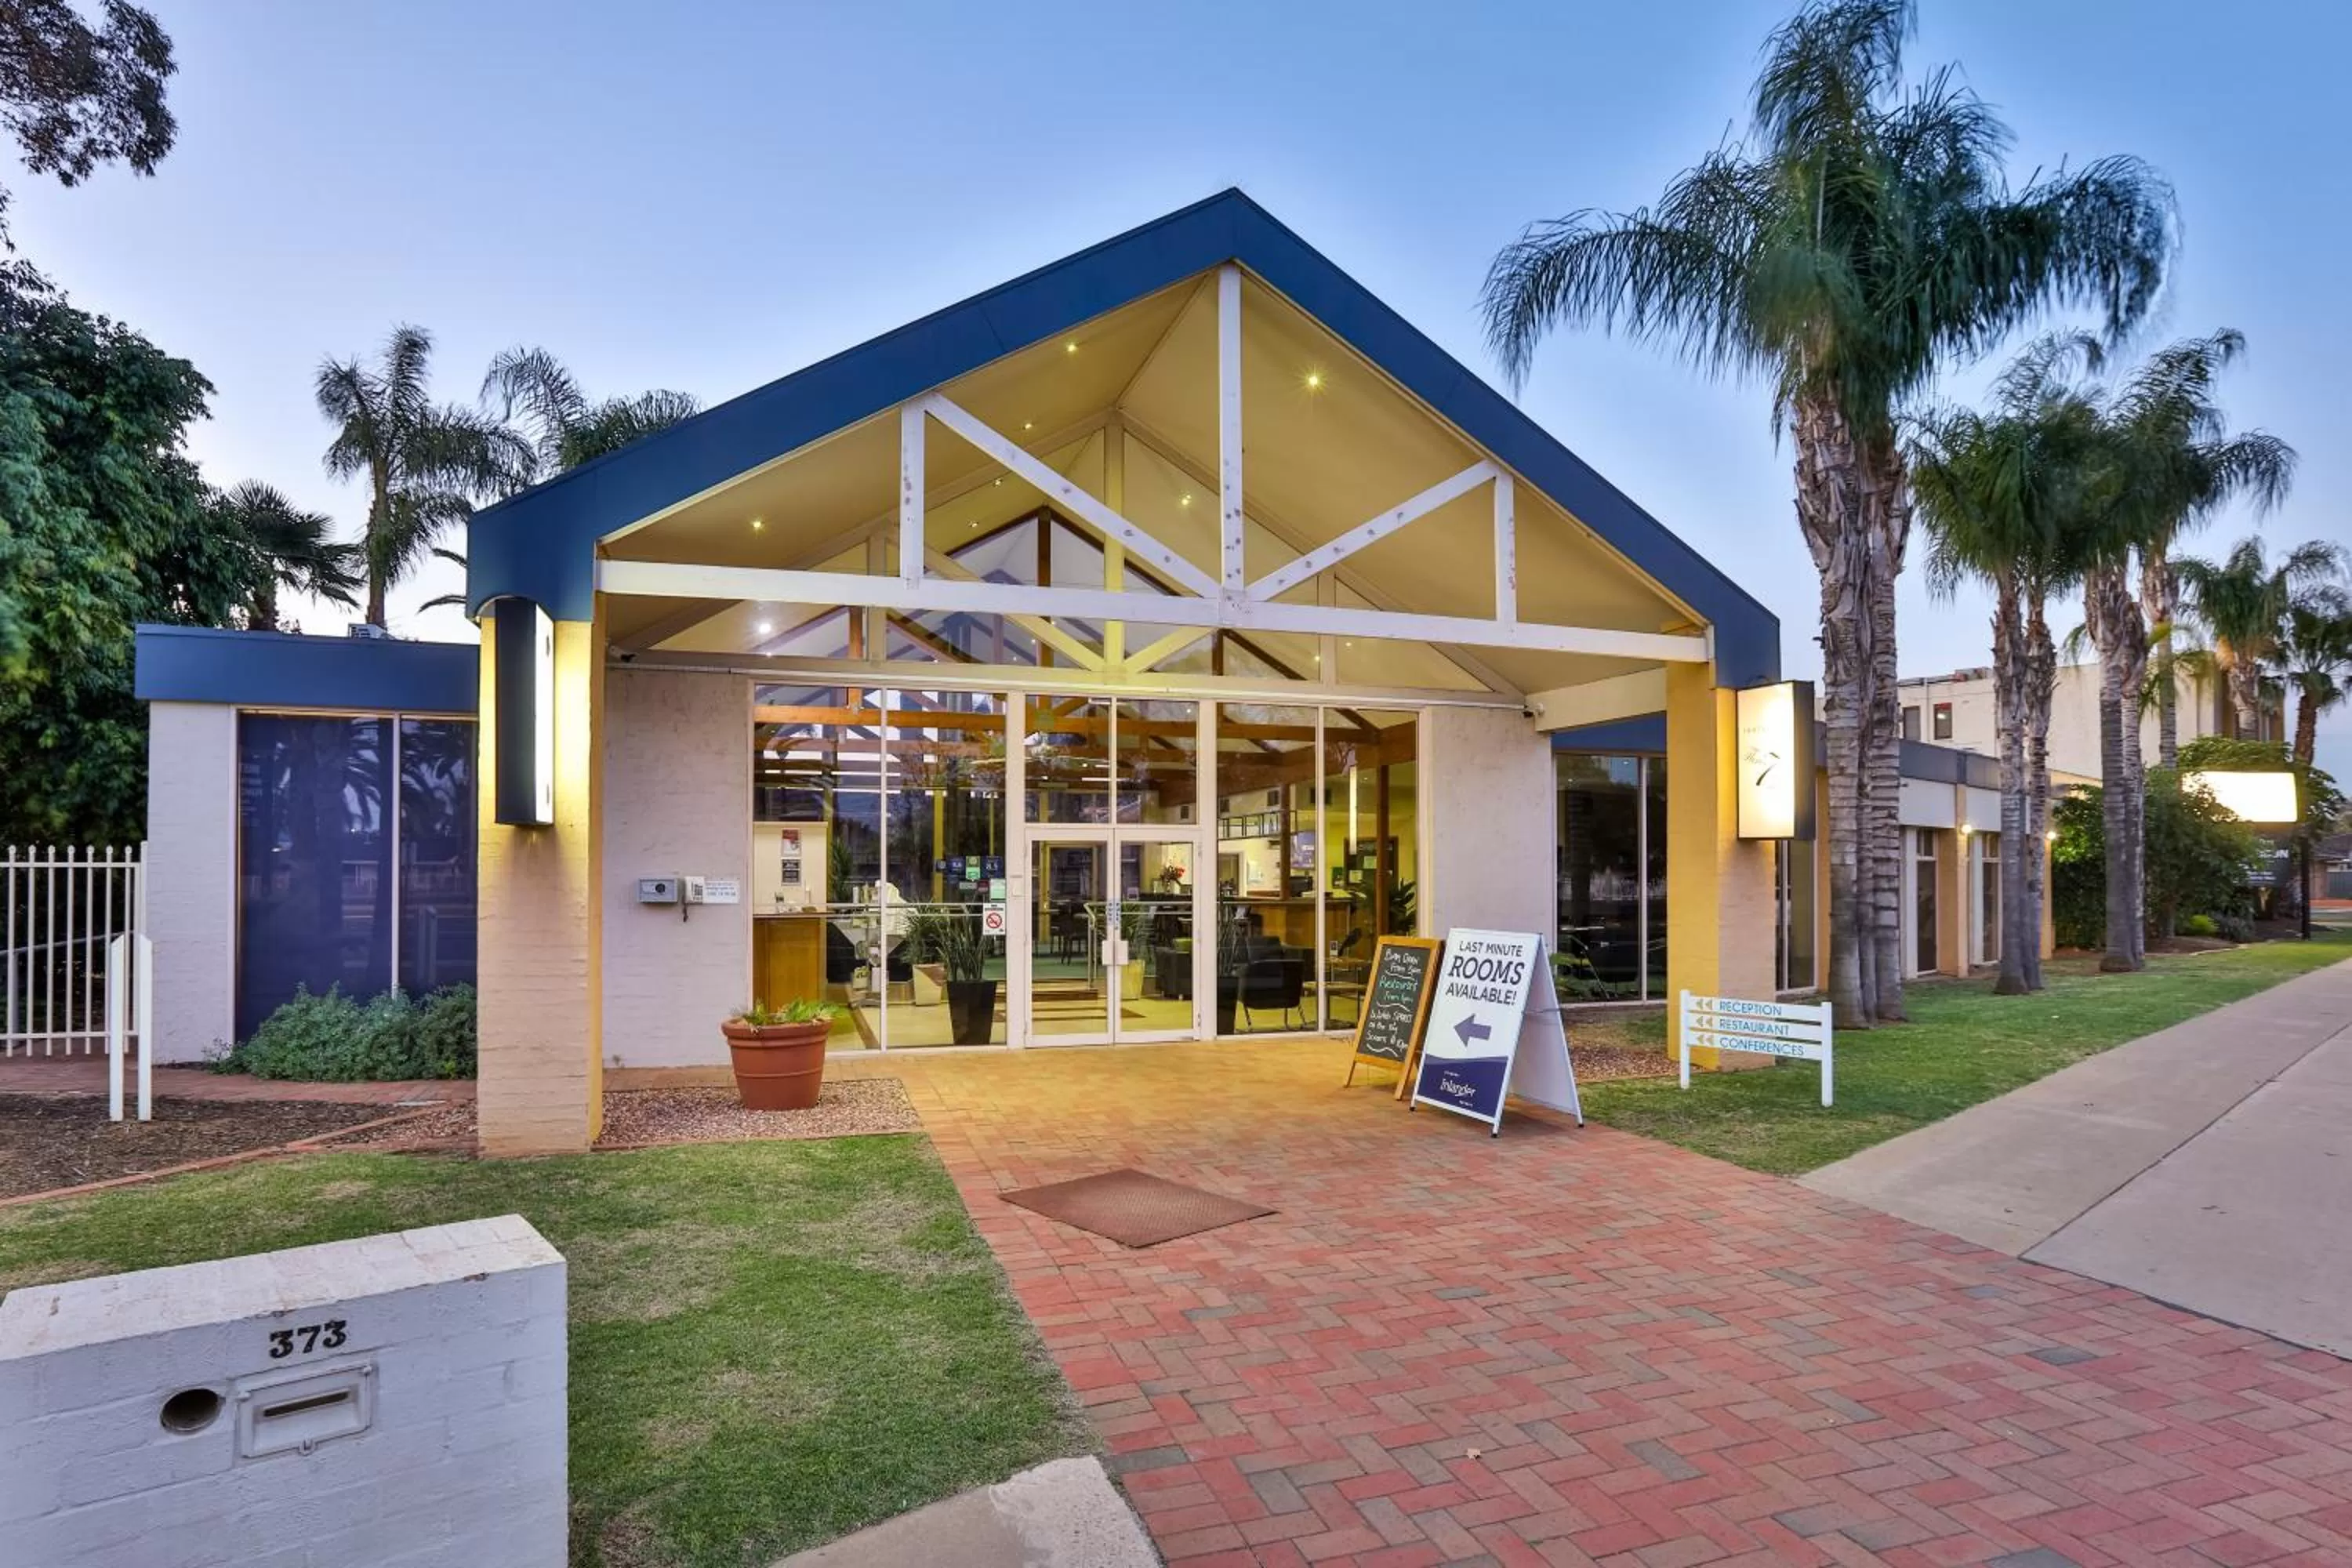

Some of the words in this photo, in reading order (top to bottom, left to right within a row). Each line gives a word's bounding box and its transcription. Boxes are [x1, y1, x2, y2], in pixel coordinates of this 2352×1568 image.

[1459, 941, 1483, 954] LAST
[1486, 943, 1523, 957] MINUTE
[1447, 955, 1525, 985] ROOMS
[1445, 982, 1517, 1005] AVAILABLE!
[1719, 1000, 1782, 1015] RECEPTION
[1719, 1018, 1789, 1036] RESTAURANT
[1719, 1036, 1804, 1056] CONFERENCES
[269, 1319, 347, 1359] 373
